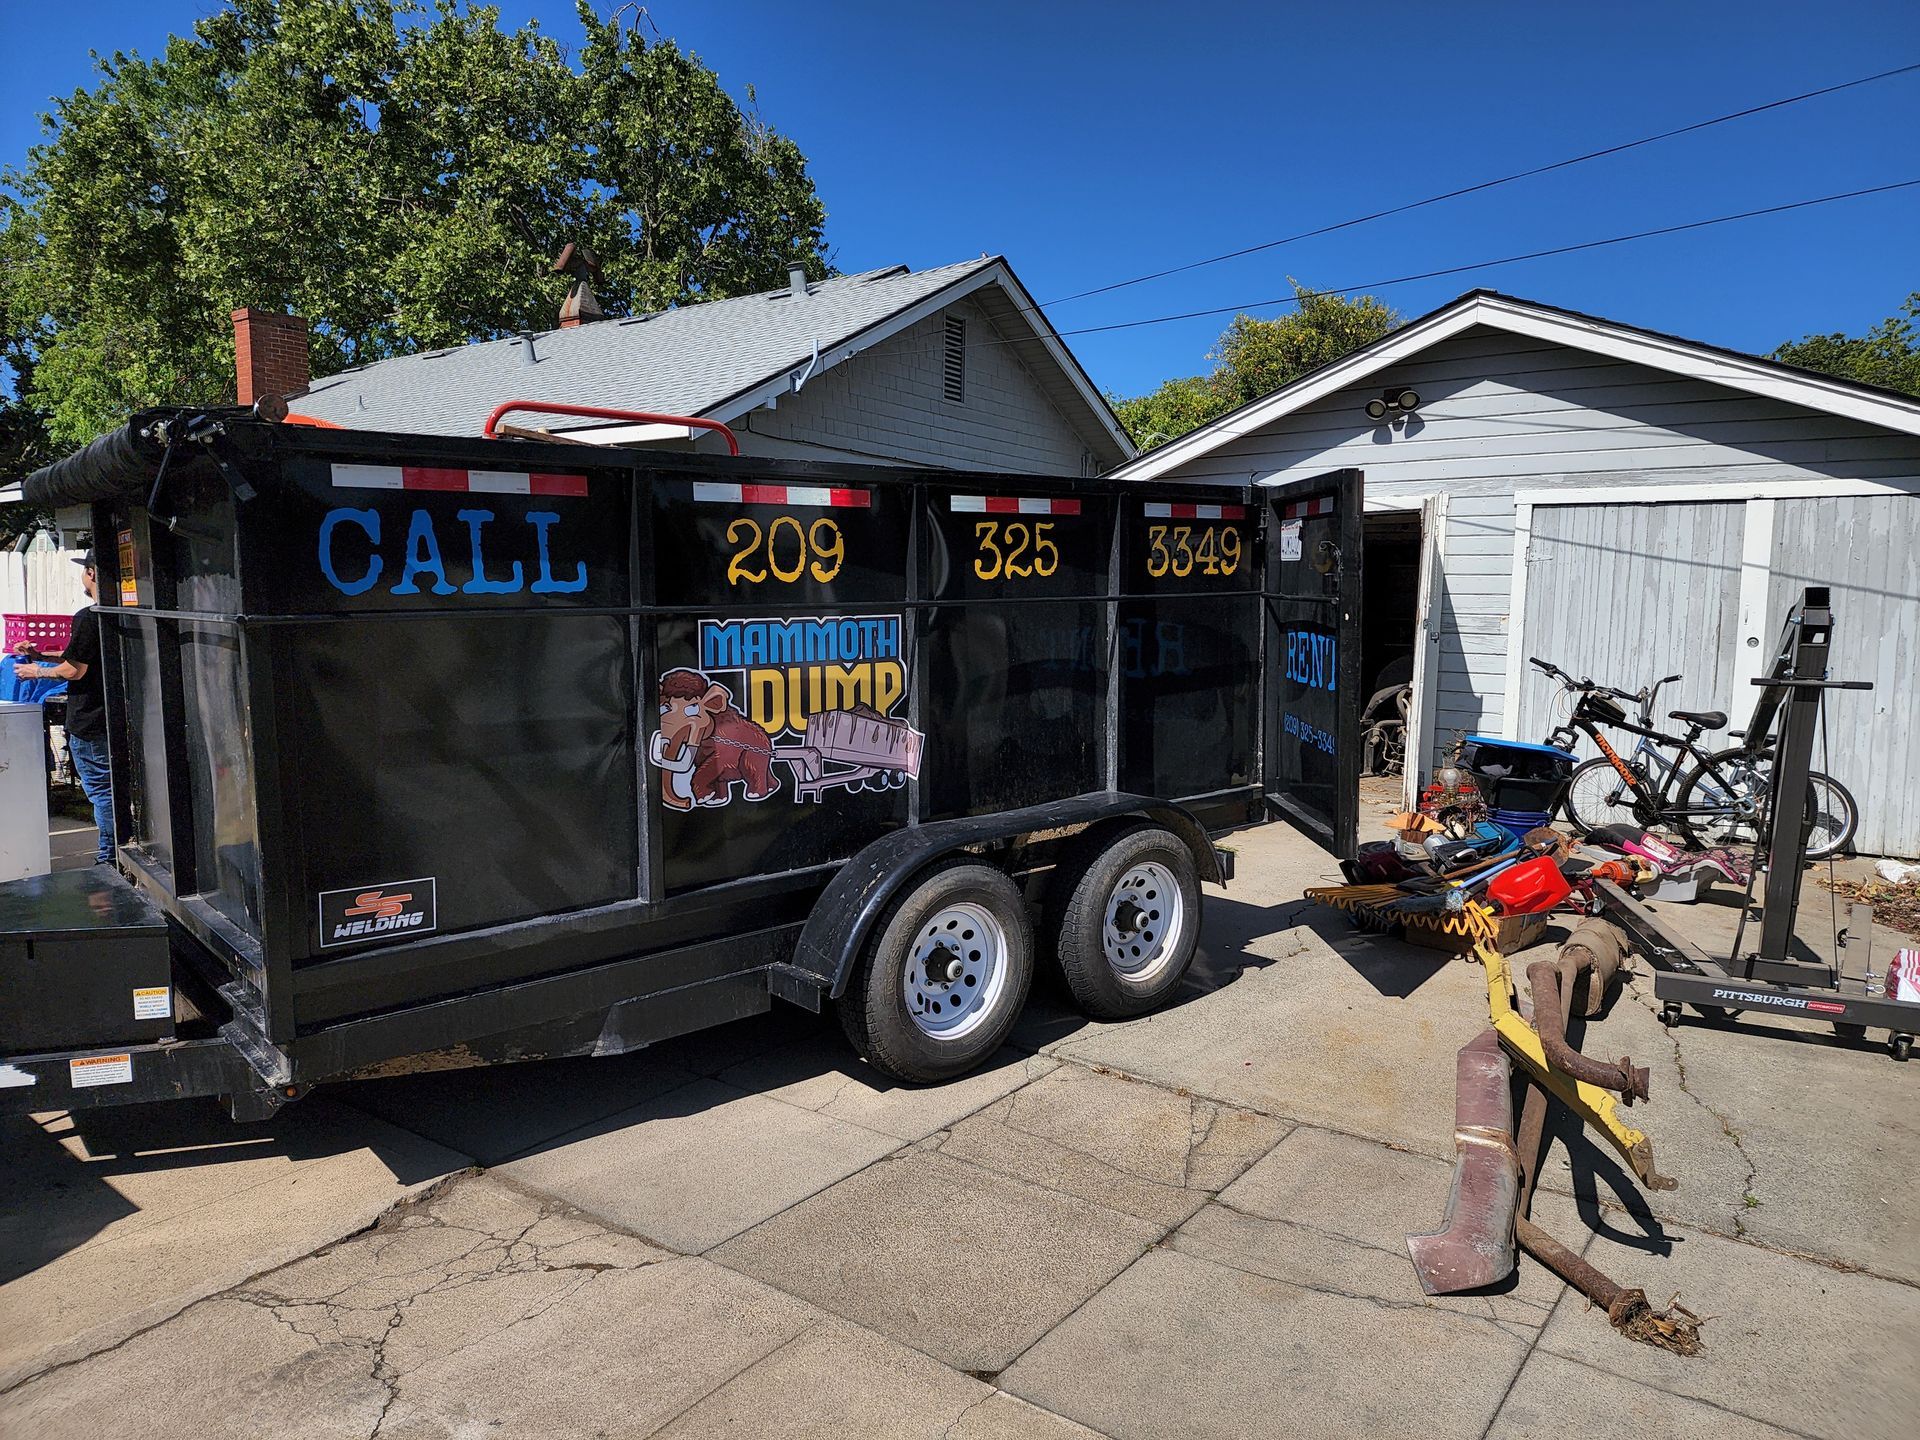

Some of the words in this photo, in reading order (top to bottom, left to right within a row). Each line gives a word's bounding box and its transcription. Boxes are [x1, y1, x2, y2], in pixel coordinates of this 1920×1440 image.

[318, 507, 588, 595] CALL
[726, 516, 845, 585] 209
[974, 521, 1059, 580] 325
[1147, 525, 1242, 577] 3349
[704, 619, 897, 667] MAMMOTH
[750, 661, 902, 734] DUMP
[1300, 721, 1335, 756] 325-334
[333, 911, 424, 939] WELDING
[1713, 989, 1809, 1009] PITTSBURGH
[86, 1056, 121, 1065] WARNING
